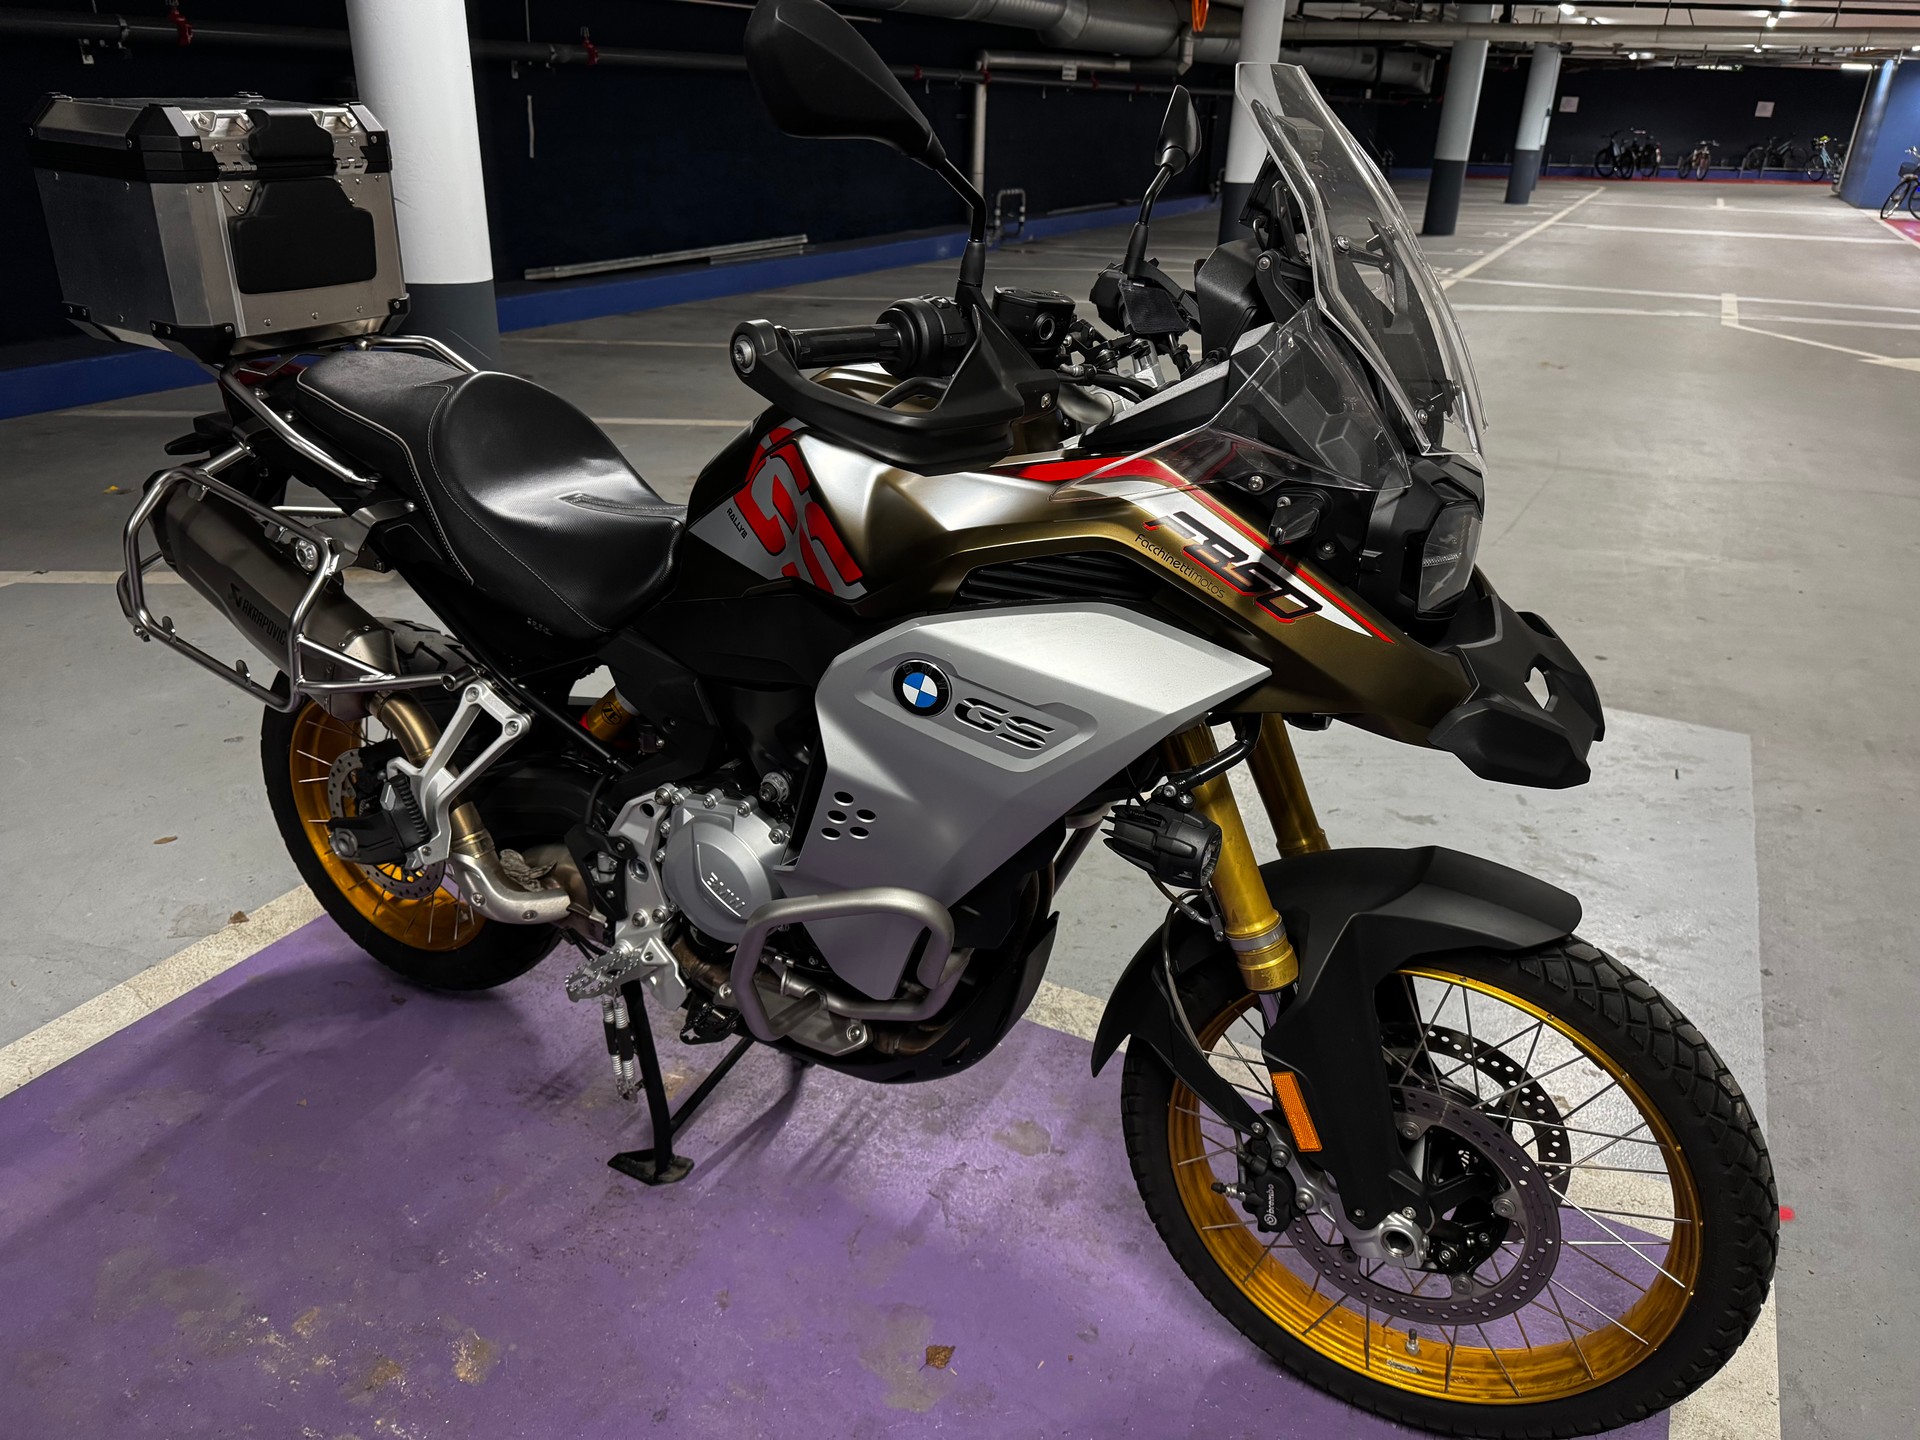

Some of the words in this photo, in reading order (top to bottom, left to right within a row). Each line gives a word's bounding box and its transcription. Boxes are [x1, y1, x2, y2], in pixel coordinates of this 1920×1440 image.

[1134, 533, 1225, 599] Facchinettimotos
[1143, 510, 1323, 624] F850
[902, 663, 948, 690] BMW
[953, 697, 1055, 751] GS
[1265, 1183, 1275, 1215] brembo
